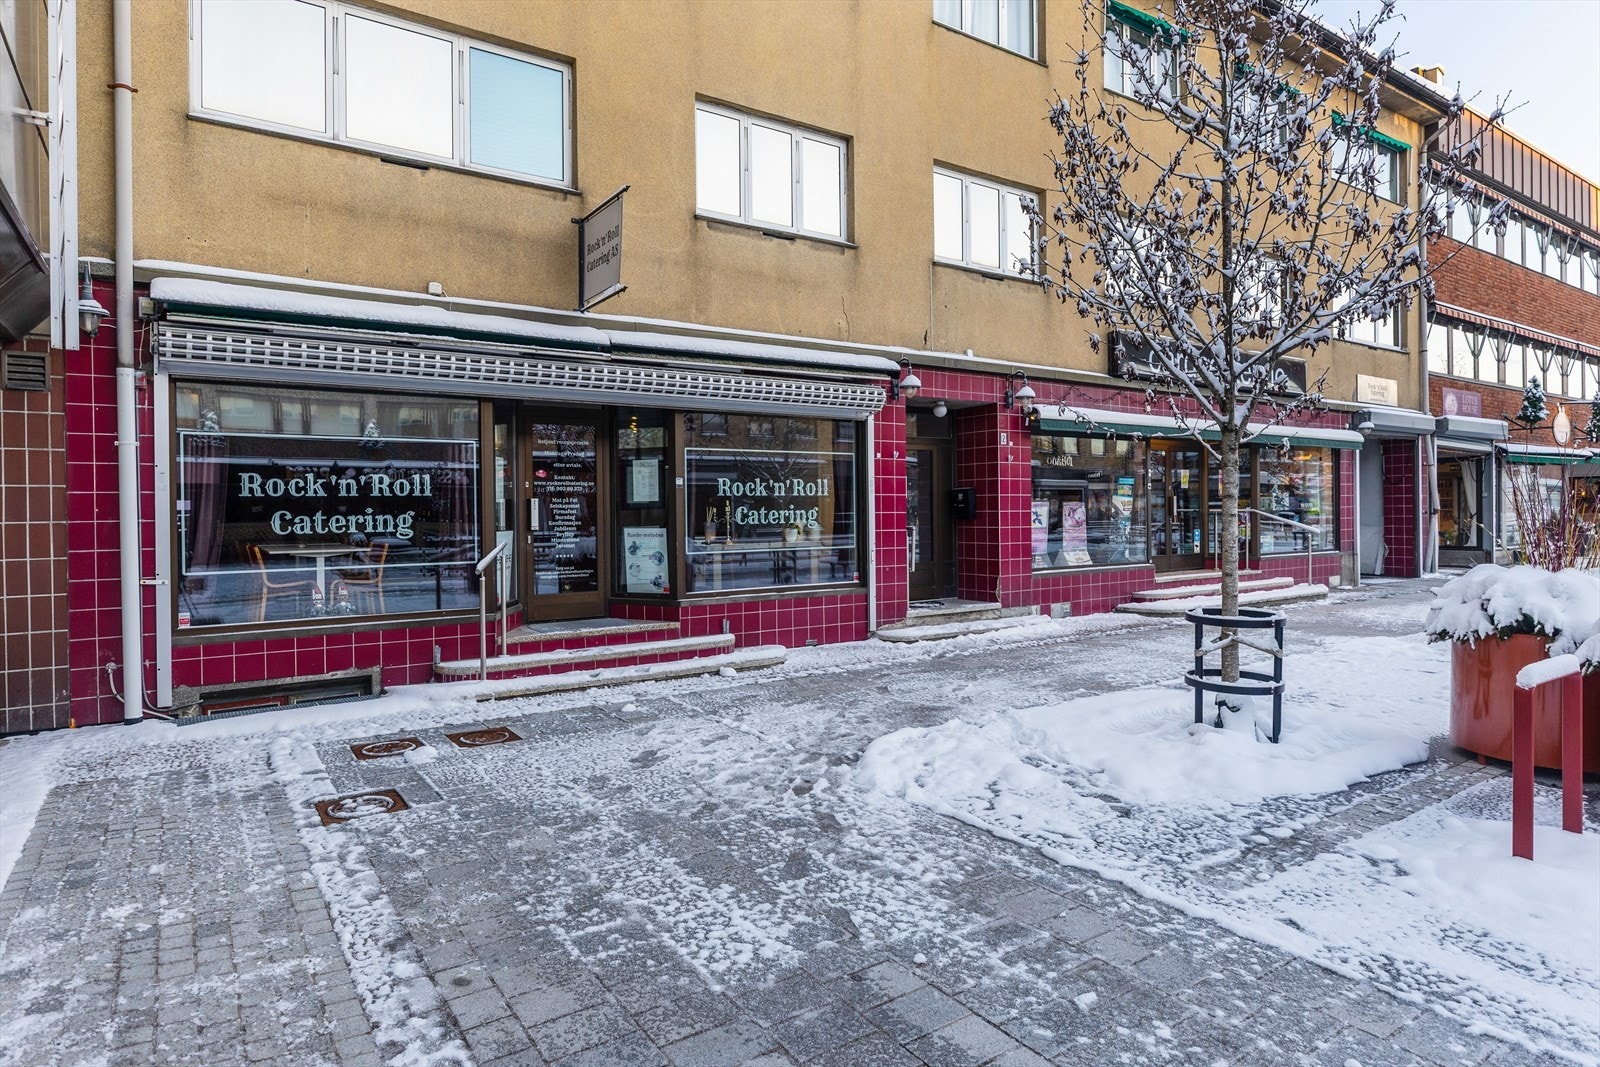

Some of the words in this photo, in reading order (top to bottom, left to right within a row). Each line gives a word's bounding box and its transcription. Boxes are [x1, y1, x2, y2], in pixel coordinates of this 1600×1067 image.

[587, 249, 610, 273] Catering
[610, 243, 619, 259] AS
[1462, 394, 1479, 406] LOTUS
[1462, 404, 1479, 415] HOUSE
[238, 472, 433, 497] Rock'n'Roll
[717, 478, 830, 497] Rock'n'Roll
[270, 507, 416, 539] Catering
[735, 504, 819, 529] Catering
